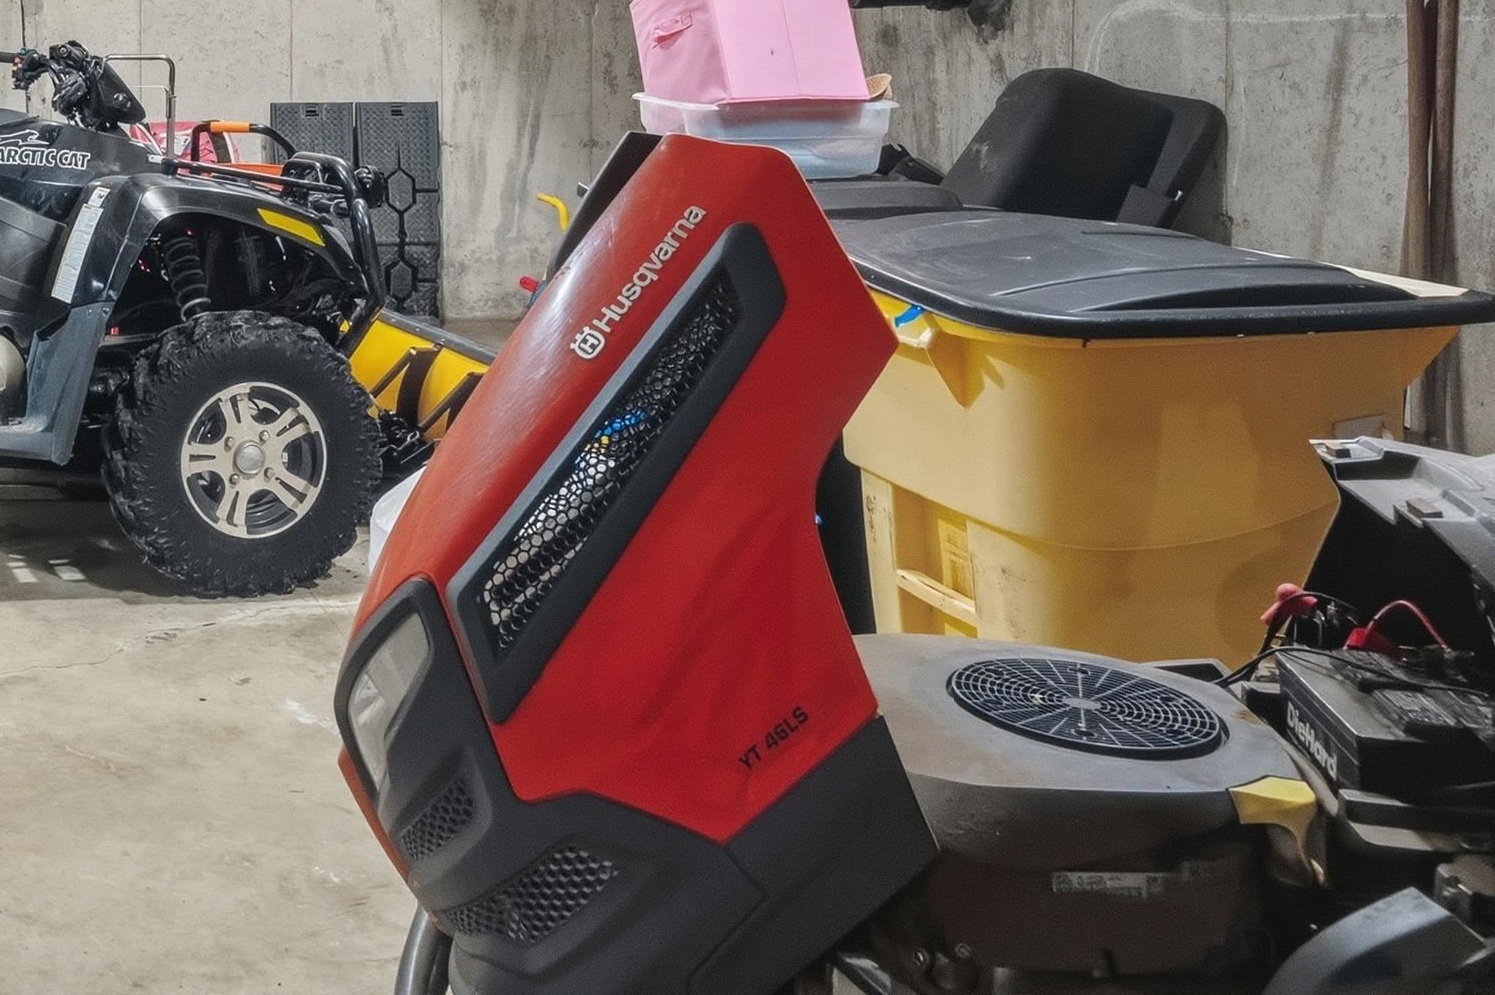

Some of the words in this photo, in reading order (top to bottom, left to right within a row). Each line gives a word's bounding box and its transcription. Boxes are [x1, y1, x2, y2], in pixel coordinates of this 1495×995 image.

[57, 150, 90, 170] CAT
[592, 205, 707, 333] Husqvarna
[738, 744, 762, 771] YT
[765, 707, 809, 750] 46LS
[1287, 701, 1337, 781] DieHard
